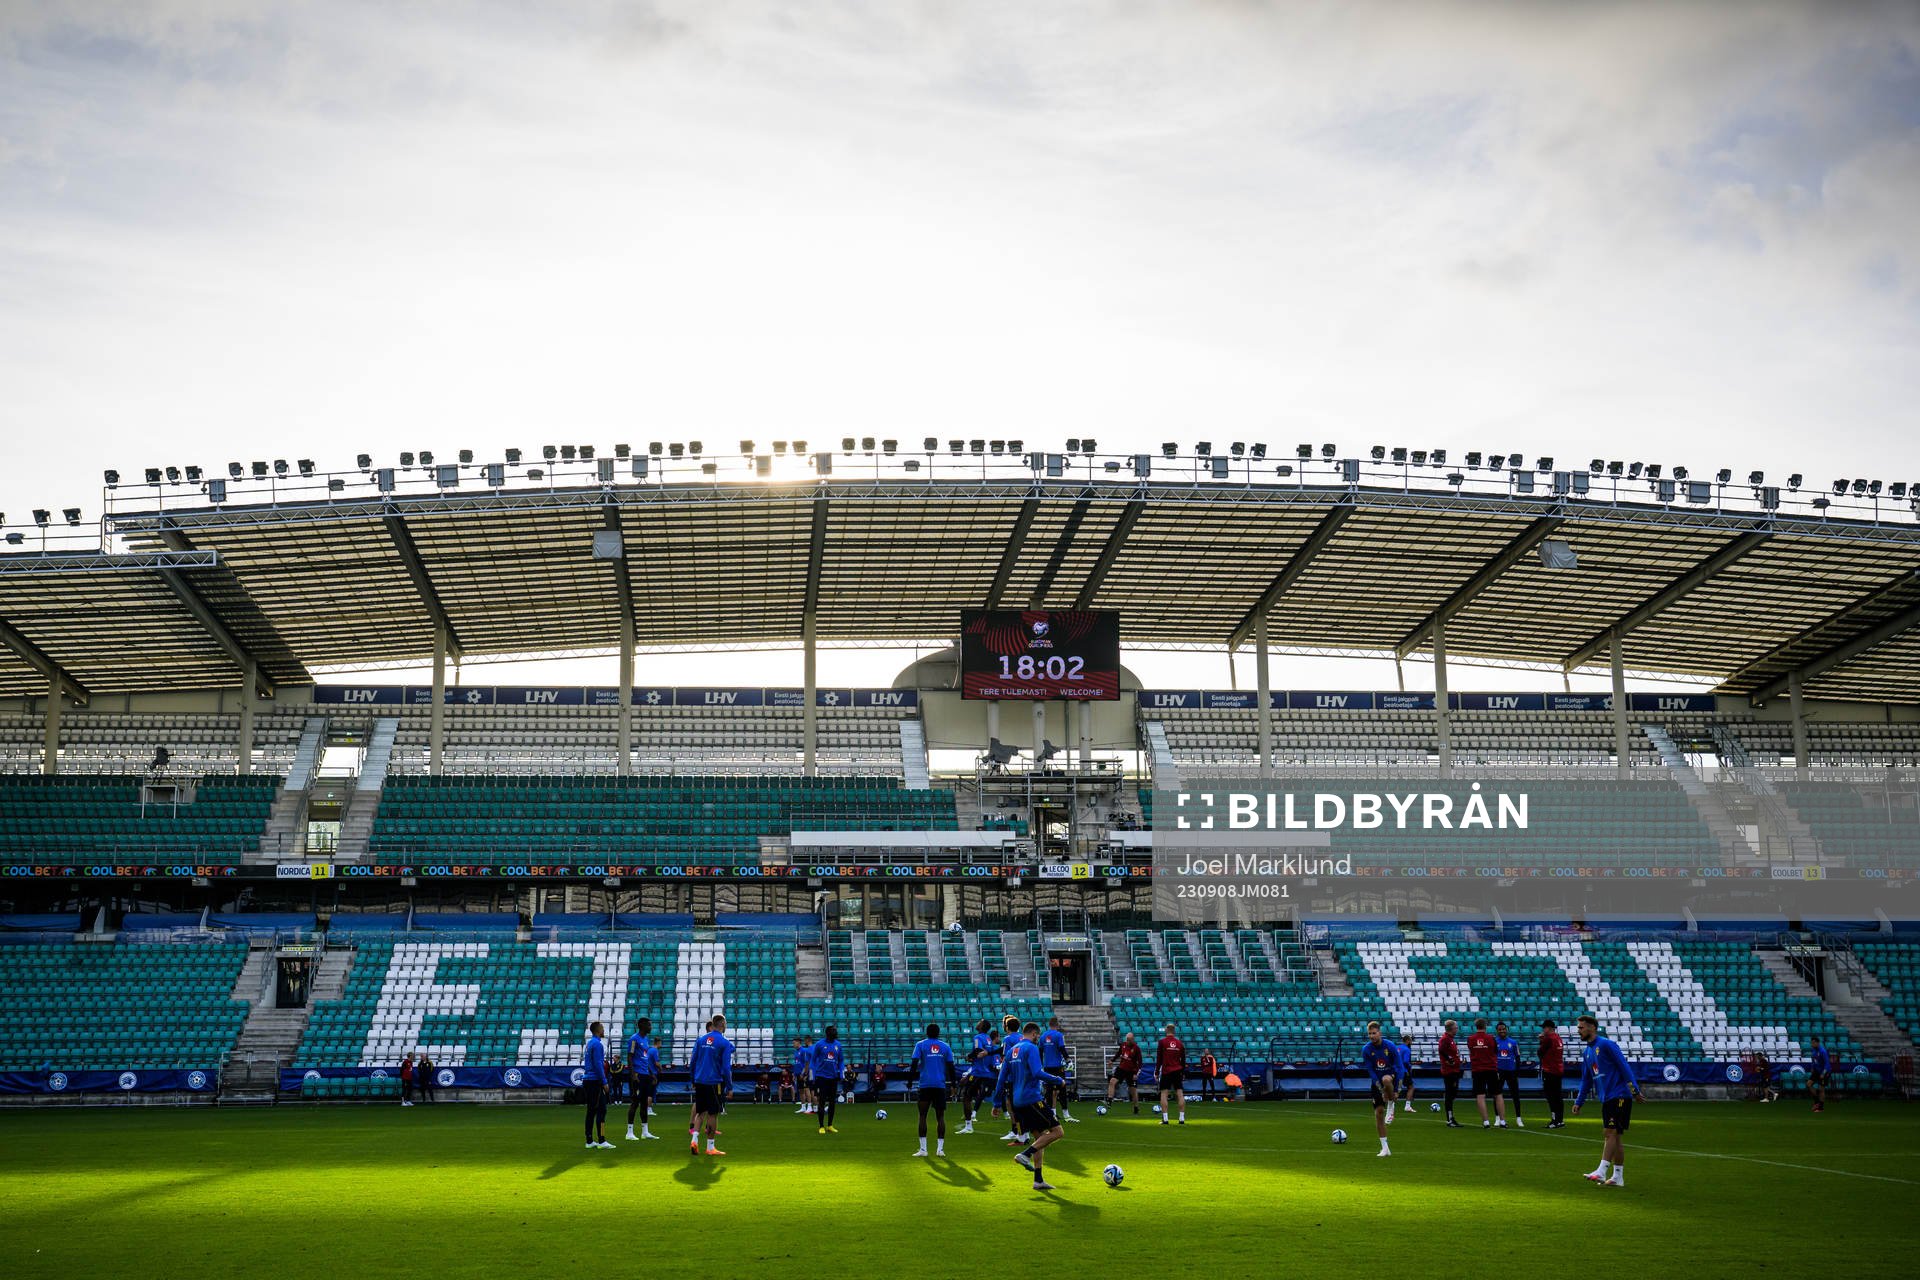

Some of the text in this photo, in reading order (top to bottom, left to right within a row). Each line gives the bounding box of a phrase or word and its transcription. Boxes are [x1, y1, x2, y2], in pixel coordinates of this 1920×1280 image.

[999, 656, 1084, 680] 18:02
[344, 690, 378, 702] LHV
[526, 691, 558, 702] LHV
[705, 692, 737, 704] LHV
[871, 693, 903, 704] LHV
[1154, 695, 1186, 706] LHV
[1316, 696, 1348, 707] LHV
[1488, 697, 1519, 708] LHV
[1658, 698, 1689, 710] LHV
[2, 866, 58, 876] COOLBET
[84, 866, 138, 876] COOLBET
[164, 866, 220, 876] COOLBET
[278, 867, 310, 876] NORDICA
[315, 866, 325, 876] 11
[343, 866, 398, 876] COOLBET
[422, 866, 475, 876] COOLBET
[500, 866, 553, 876] COOLBET
[578, 866, 631, 876] COOLBET
[655, 866, 708, 876] COOLBET
[732, 866, 785, 876] COOLBET
[809, 866, 861, 876] COOLBET
[885, 866, 938, 876] COOLBET
[1074, 867, 1086, 876] 12
[1772, 869, 1818, 878] COOLBET 13
